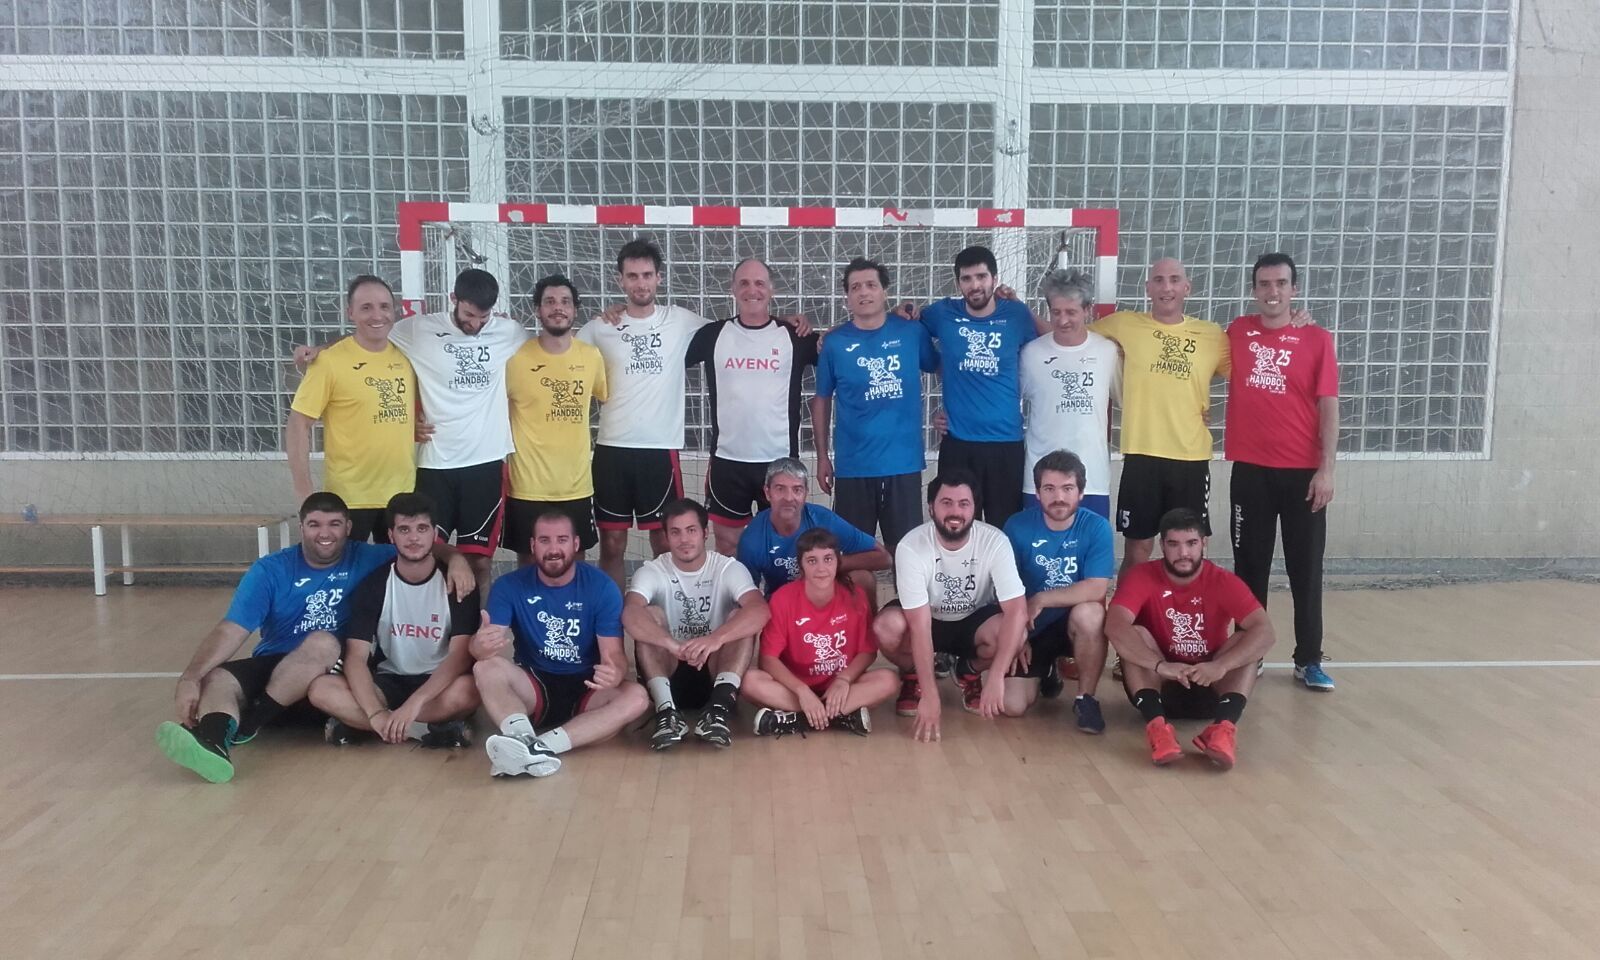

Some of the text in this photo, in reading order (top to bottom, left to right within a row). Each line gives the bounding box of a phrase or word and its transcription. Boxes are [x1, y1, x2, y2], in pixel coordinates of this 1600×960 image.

[651, 333, 662, 348] 25
[988, 332, 1001, 349] 25
[1183, 338, 1196, 353] 25
[477, 346, 490, 362] 25
[1276, 349, 1292, 366] 25
[631, 360, 662, 370] HANDBOL
[725, 358, 780, 373] AVENÇ
[887, 354, 900, 371] 25
[964, 359, 998, 369] HANDBOL
[1156, 361, 1191, 374] HANDBOL
[394, 377, 406, 393] 25
[454, 376, 489, 385] HANDBOL
[1082, 372, 1094, 386] 25
[1249, 374, 1286, 387] HANDBOL
[572, 380, 583, 395] 25
[869, 383, 903, 395] HANDBOL
[1060, 400, 1093, 409] HANDBOL
[551, 409, 583, 417] HANDBOL
[1064, 556, 1078, 574] 25
[965, 574, 976, 591] 25
[328, 588, 343, 606] 25
[699, 596, 711, 612] 25
[566, 619, 580, 636] 25
[834, 630, 847, 648] 25
[544, 646, 581, 659] HANDBOL
